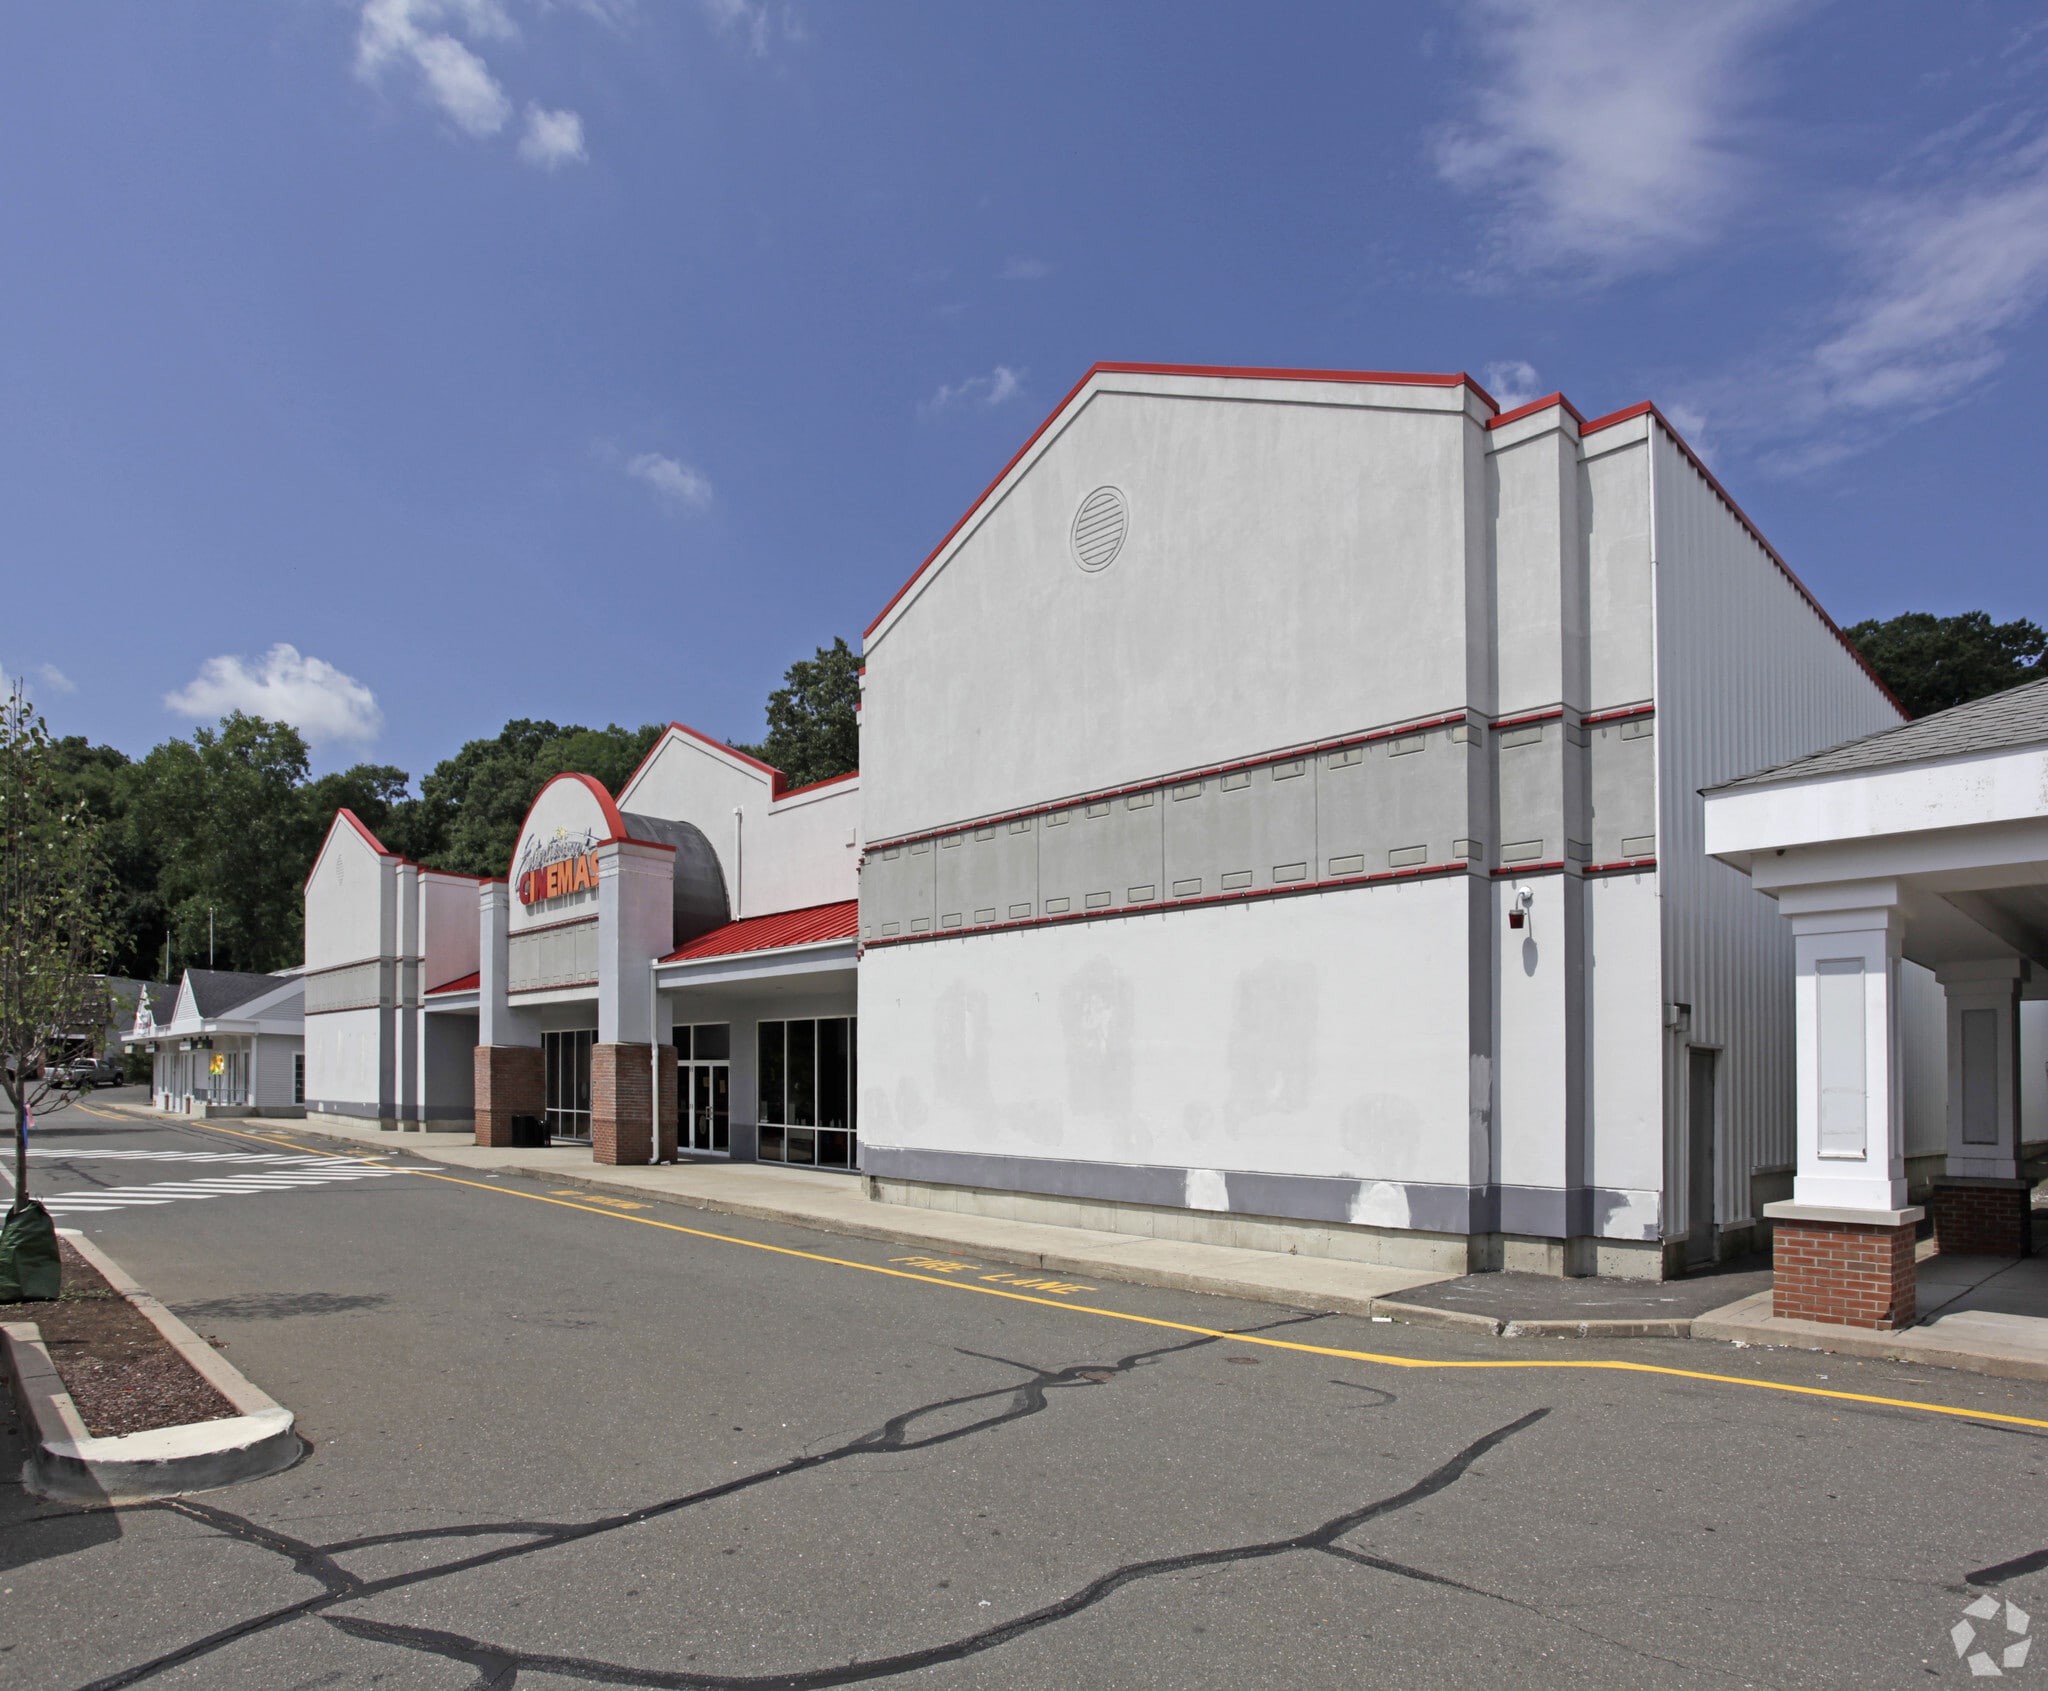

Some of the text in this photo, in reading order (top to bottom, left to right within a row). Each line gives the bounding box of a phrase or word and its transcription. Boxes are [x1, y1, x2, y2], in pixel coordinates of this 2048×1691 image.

[519, 850, 599, 905] CINEMAS
[888, 1256, 1098, 1295] FIRE LANE
